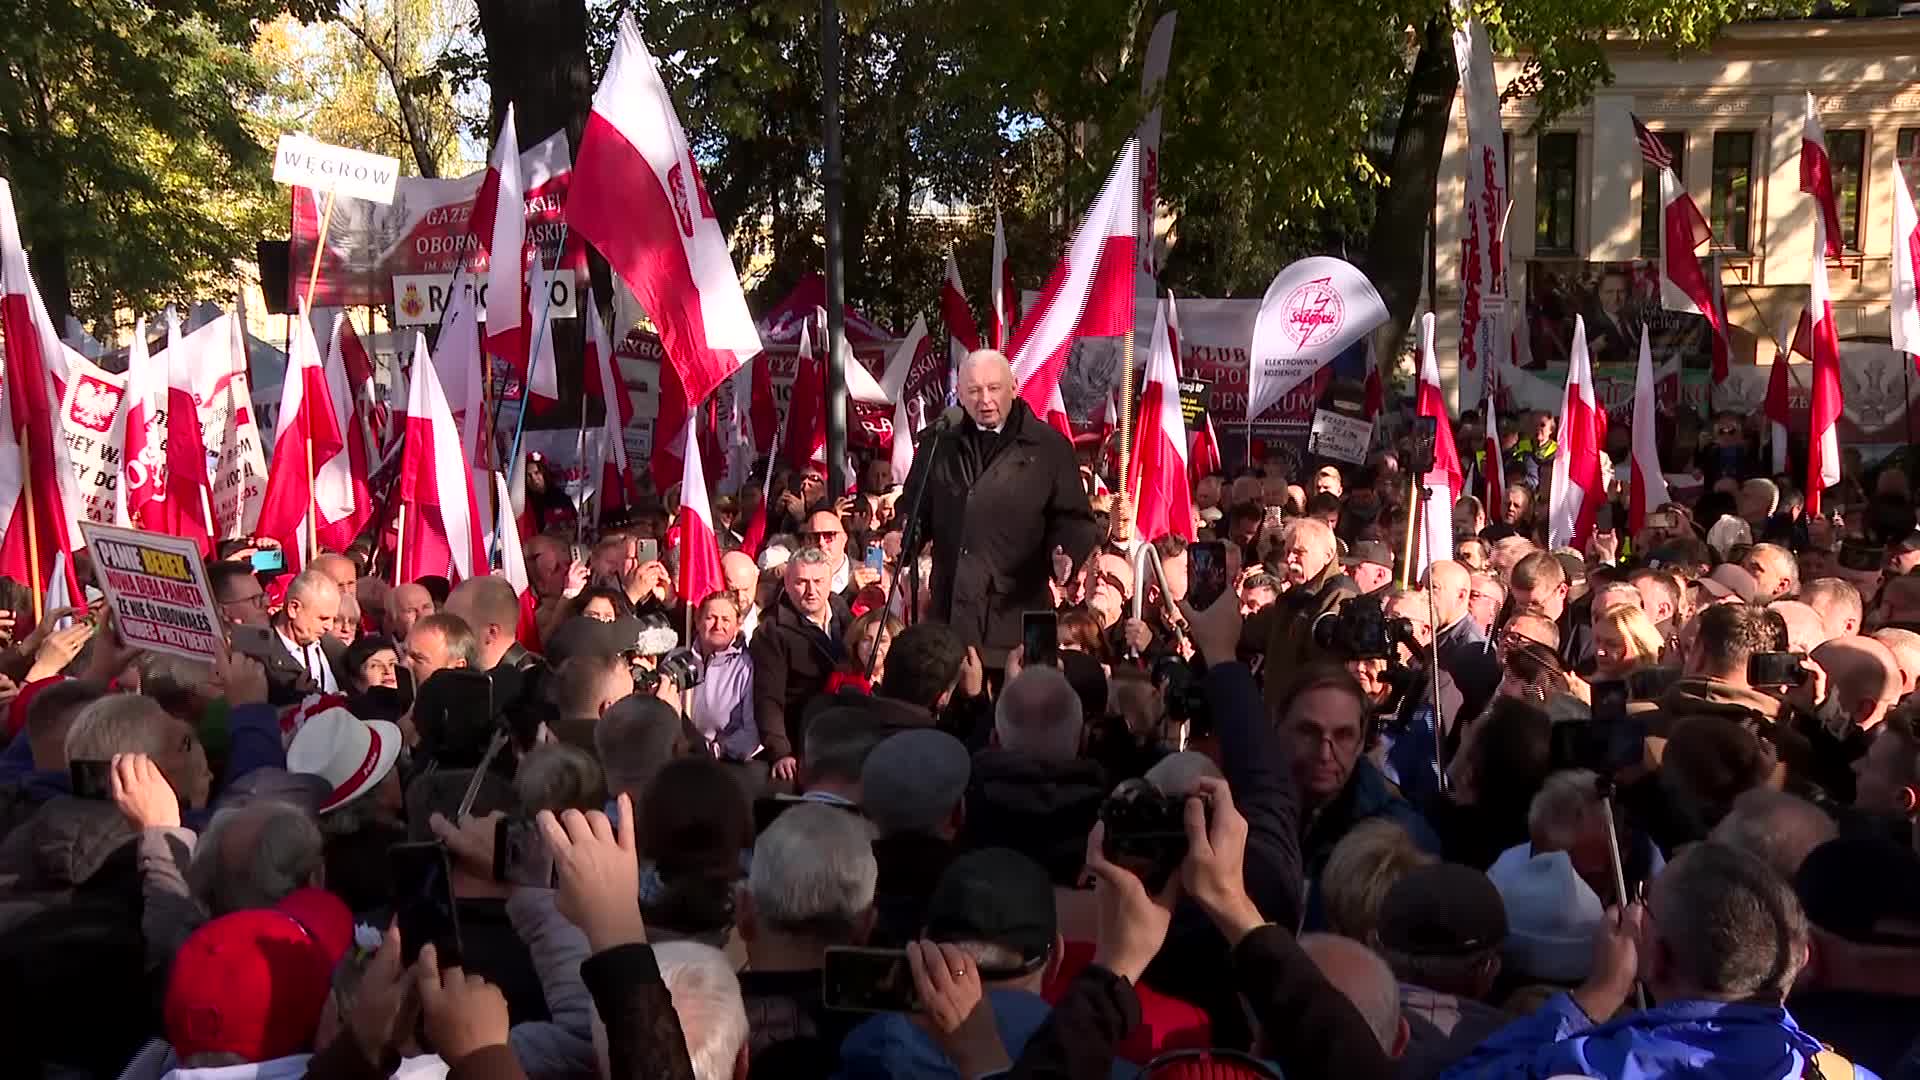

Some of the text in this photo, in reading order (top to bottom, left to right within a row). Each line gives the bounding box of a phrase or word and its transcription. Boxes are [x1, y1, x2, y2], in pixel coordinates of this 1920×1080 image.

[427, 207, 470, 225] GAZE
[1209, 391, 1316, 412] CENRUM
[97, 541, 145, 573] PANIE
